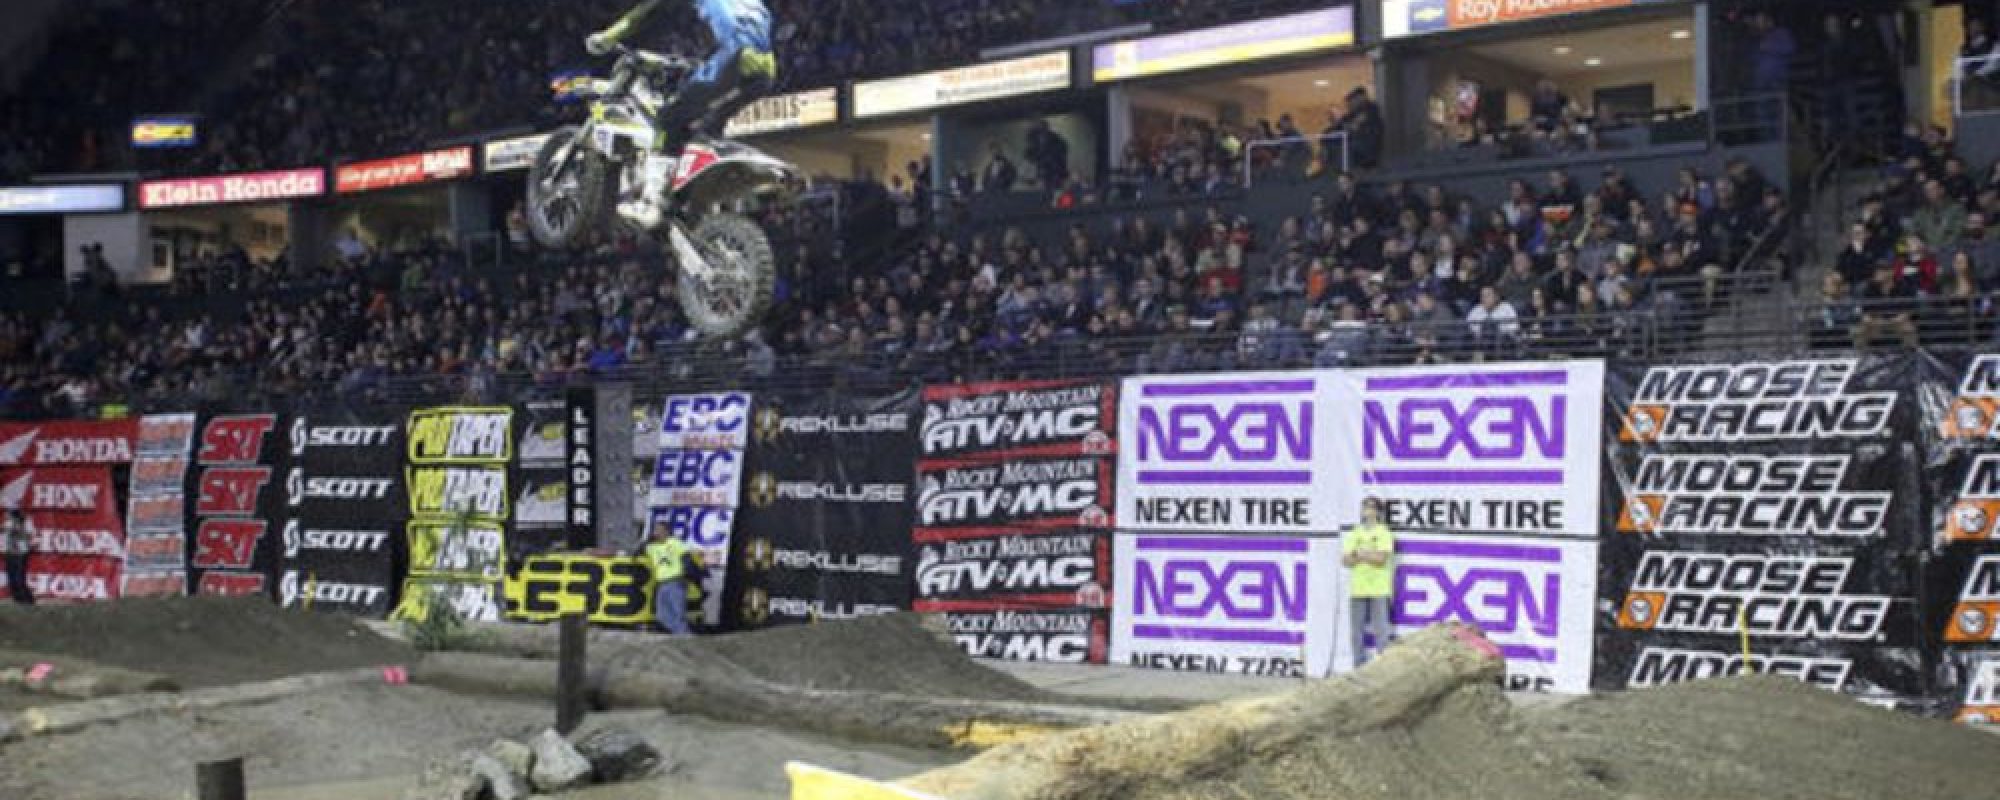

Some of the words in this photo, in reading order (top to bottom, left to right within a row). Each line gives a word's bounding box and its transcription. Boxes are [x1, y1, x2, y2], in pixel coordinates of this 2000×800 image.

[144, 181, 218, 207] Klein
[223, 172, 318, 200] Honda
[1634, 360, 1857, 400] MOOSE
[663, 394, 745, 432] EBC
[780, 413, 908, 434] REKLUSE
[1139, 401, 1312, 462] NEXEN
[1363, 396, 1567, 459] NEXEN
[1660, 392, 1897, 439] RACING
[34, 437, 132, 462] HONDA
[198, 414, 276, 464] SRT
[309, 425, 396, 445] SCOTT
[572, 406, 591, 525] LEADER
[656, 451, 734, 487] EBC
[1634, 454, 1851, 493] MOOSE
[196, 467, 272, 515] SRT
[304, 477, 392, 497] SCOTT
[776, 481, 906, 502] REKLUSE
[1136, 498, 1231, 525] NEXEN
[1242, 499, 1311, 526] TIRE
[1378, 500, 1471, 528] EXEN
[1482, 501, 1564, 529] TIRE
[1657, 492, 1892, 536] RACING
[194, 519, 268, 567] SRT
[302, 530, 388, 550] SCOTT
[773, 550, 902, 575] REKLUSE
[1631, 551, 1854, 595] MOOSE
[1133, 559, 1307, 621] NEXEN
[1394, 564, 1560, 637] EXEN
[949, 615, 992, 632] OCKY
[1657, 593, 1890, 639] RACING
